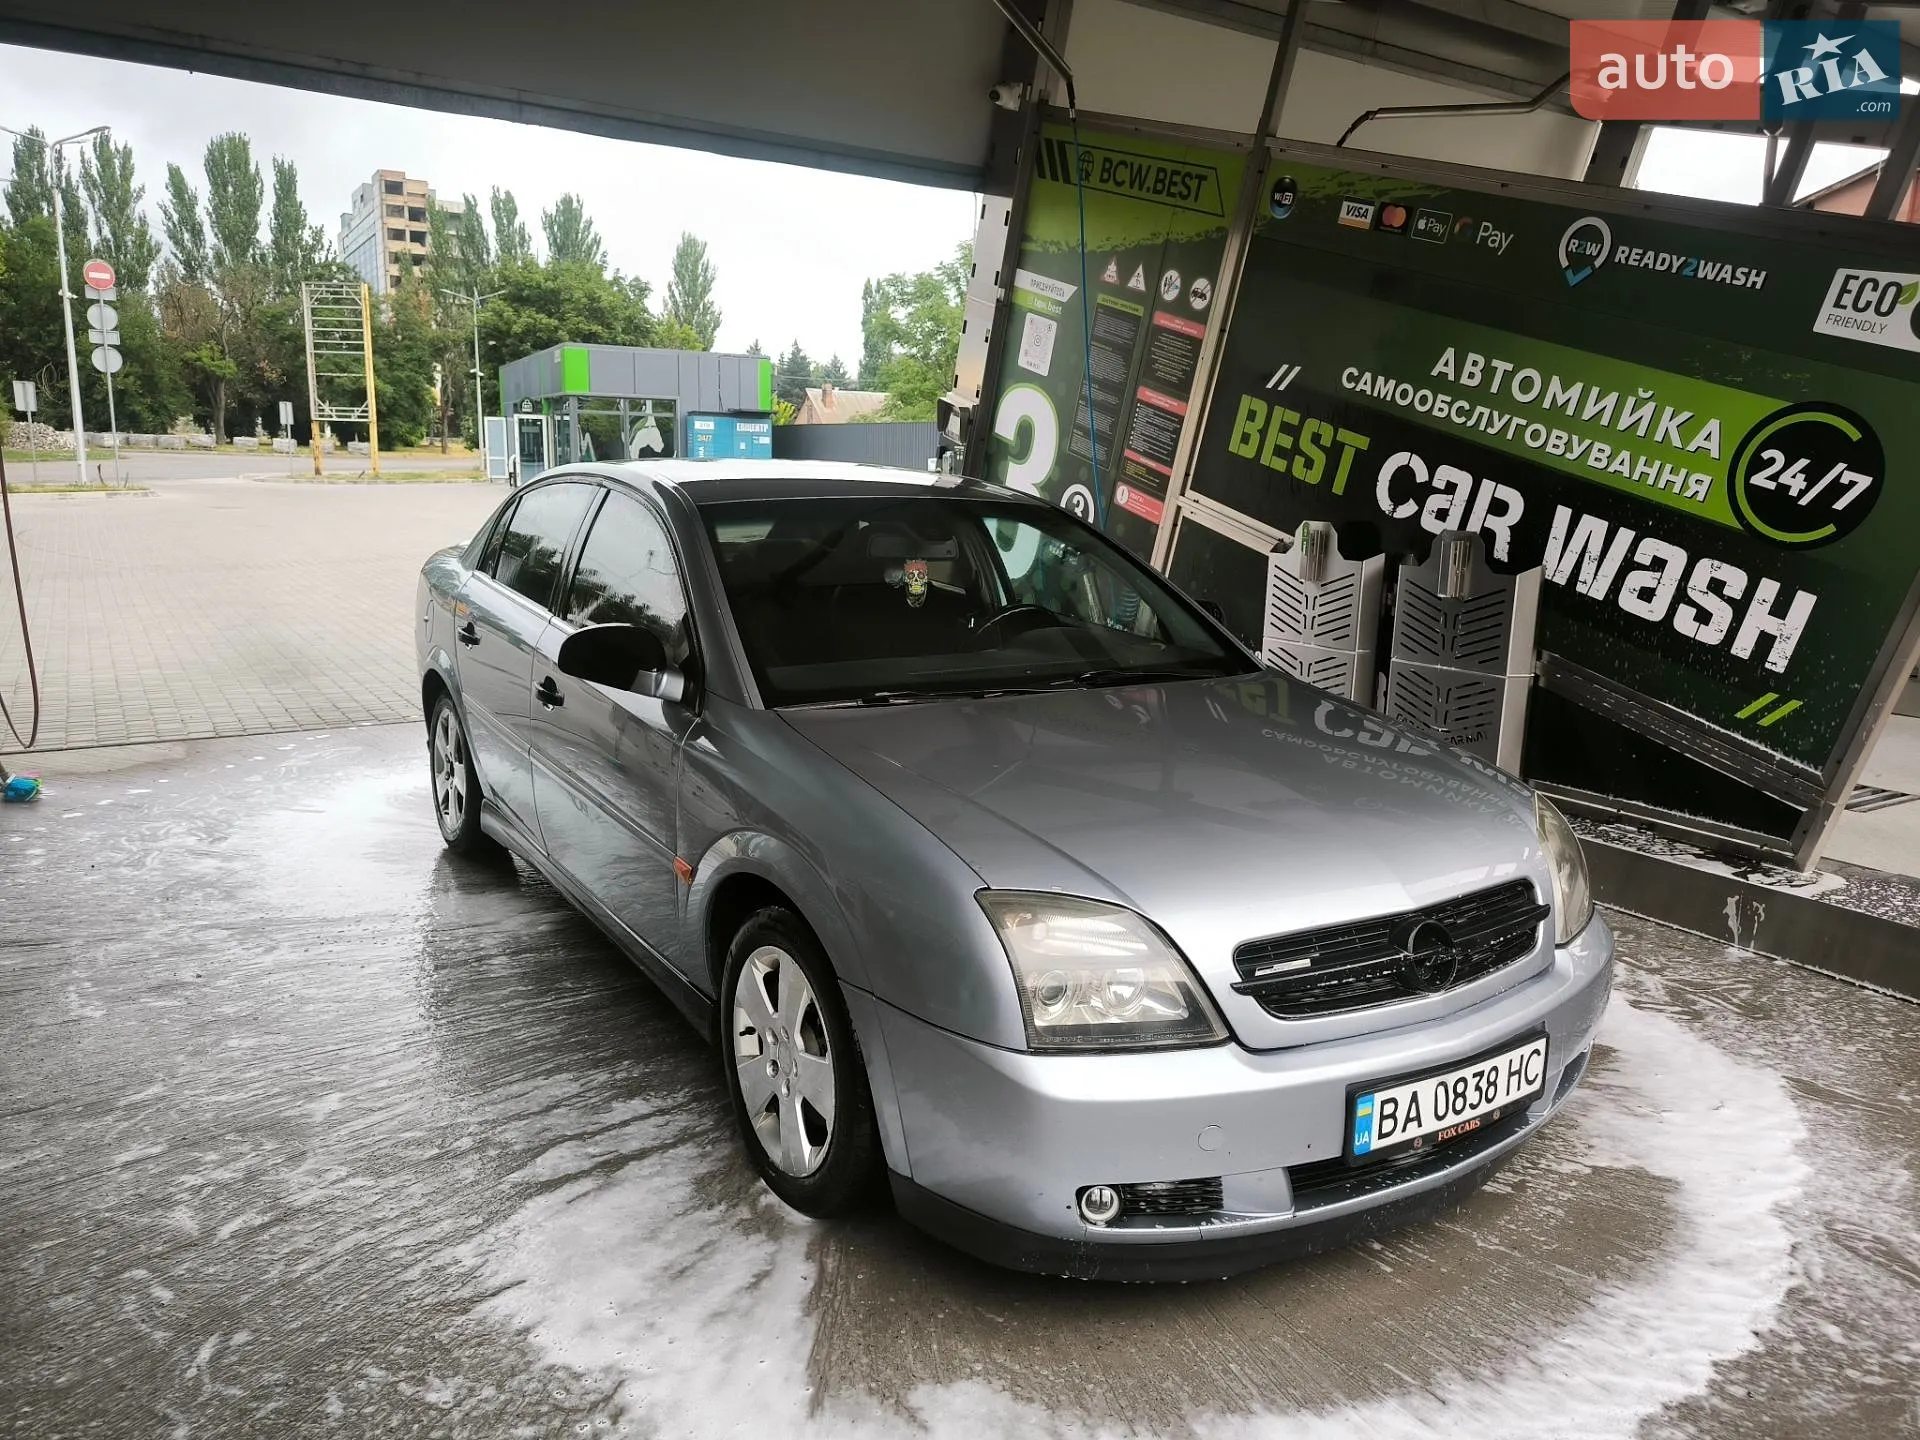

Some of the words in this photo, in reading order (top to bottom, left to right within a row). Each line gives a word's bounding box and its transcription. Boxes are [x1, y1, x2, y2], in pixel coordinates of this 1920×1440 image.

[1099, 157, 1208, 203] BCW.BEST
[1345, 204, 1369, 220] VISA
[1427, 217, 1447, 236] Pay
[1476, 221, 1514, 255] Pay
[1568, 238, 1602, 257] R2W
[1615, 245, 1768, 291] READY2WASH
[1832, 273, 1904, 318] ECO
[1825, 313, 1888, 335] FRIENDLY
[1431, 346, 1722, 460] АВТОМИЙКА
[1228, 394, 1371, 496] BEST
[1341, 366, 1714, 504] САМООБСЛУГОВУВАННЯ
[1749, 448, 1874, 511] 24/7
[1377, 1089, 1423, 1141] BA
[1433, 1065, 1499, 1122] 0838
[1506, 1048, 1542, 1096] HC
[1355, 1131, 1370, 1146] UA
[1438, 1127, 1457, 1142] FOX
[1457, 1119, 1482, 1135] CARS
